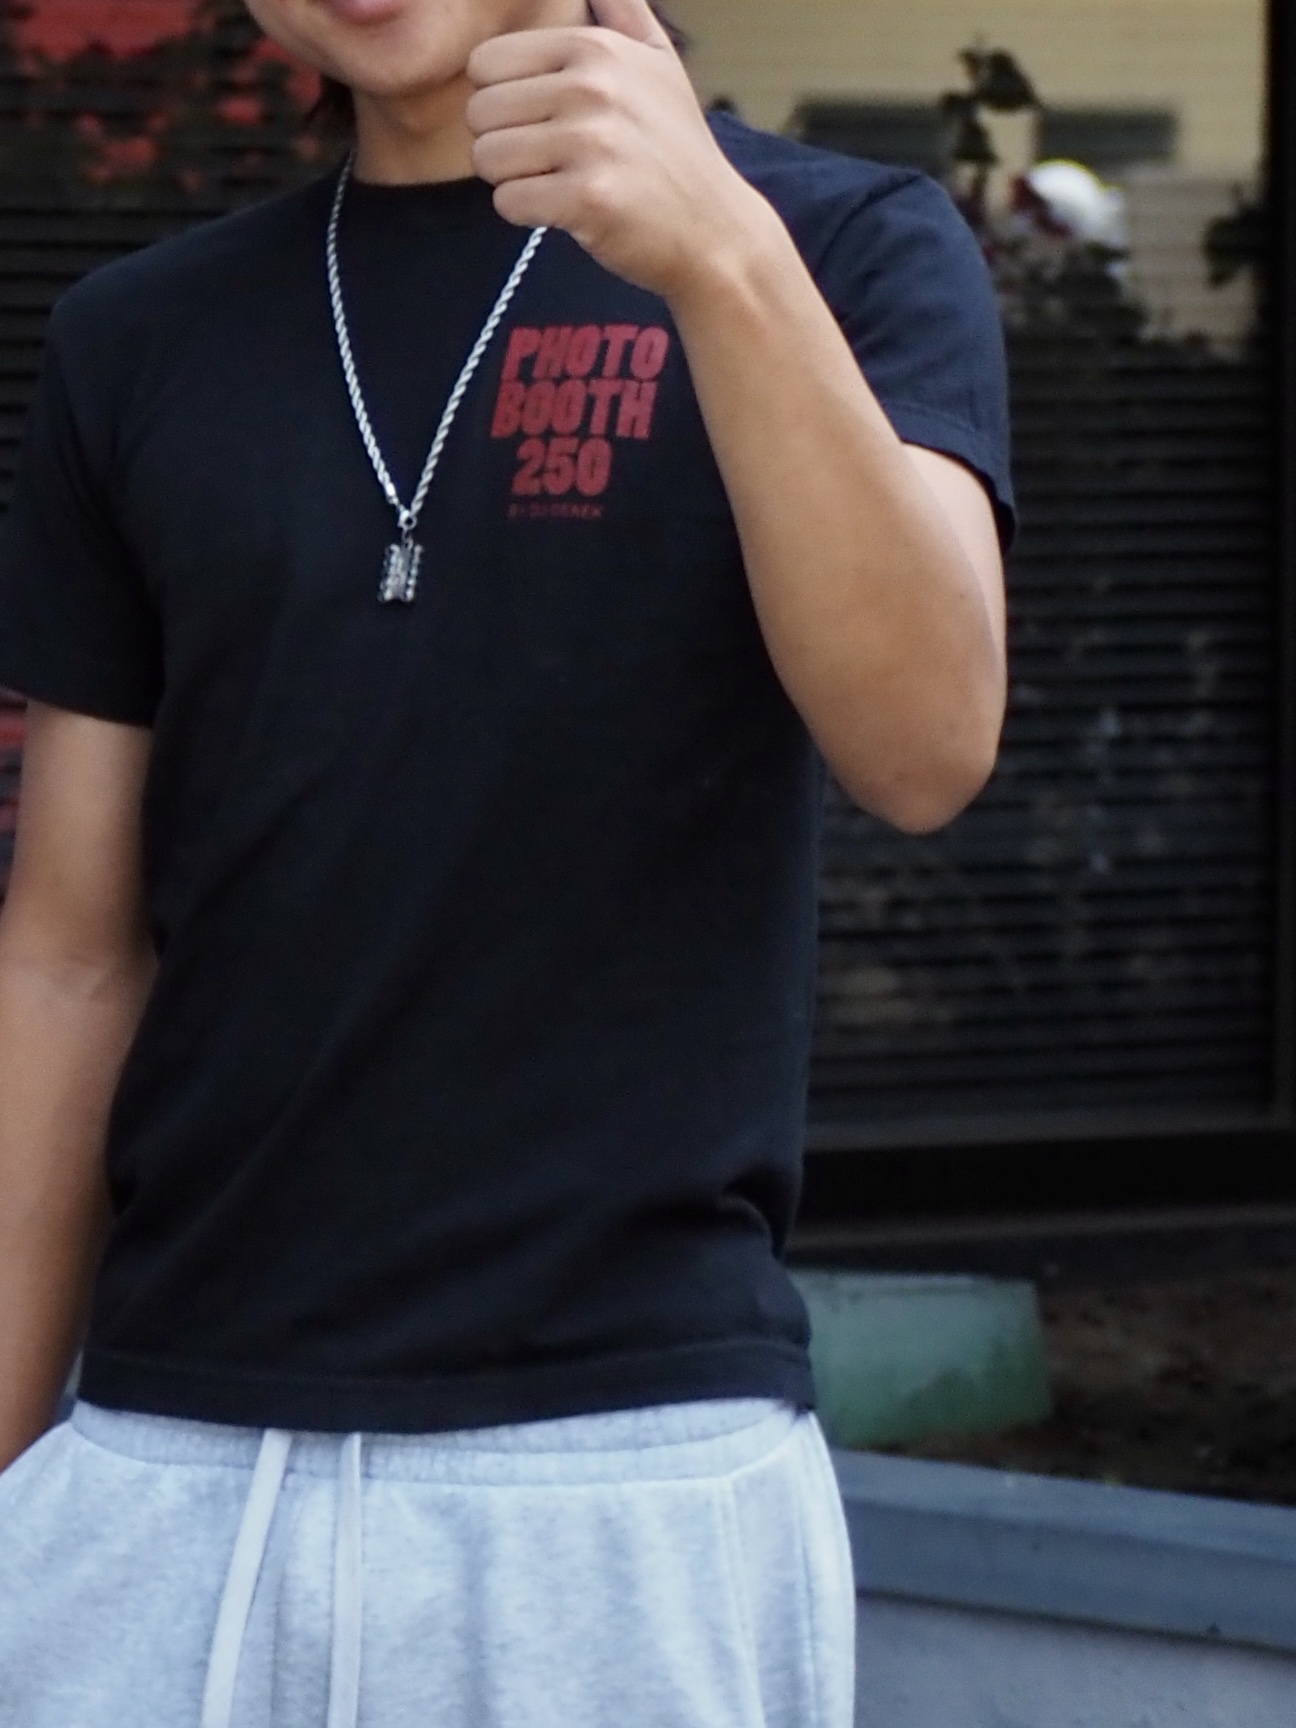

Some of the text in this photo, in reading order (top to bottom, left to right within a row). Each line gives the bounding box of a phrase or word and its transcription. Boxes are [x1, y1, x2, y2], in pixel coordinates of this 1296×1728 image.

[501, 325, 669, 379] PHOTO
[490, 378, 658, 439] BOOTH
[512, 436, 613, 496] 250
